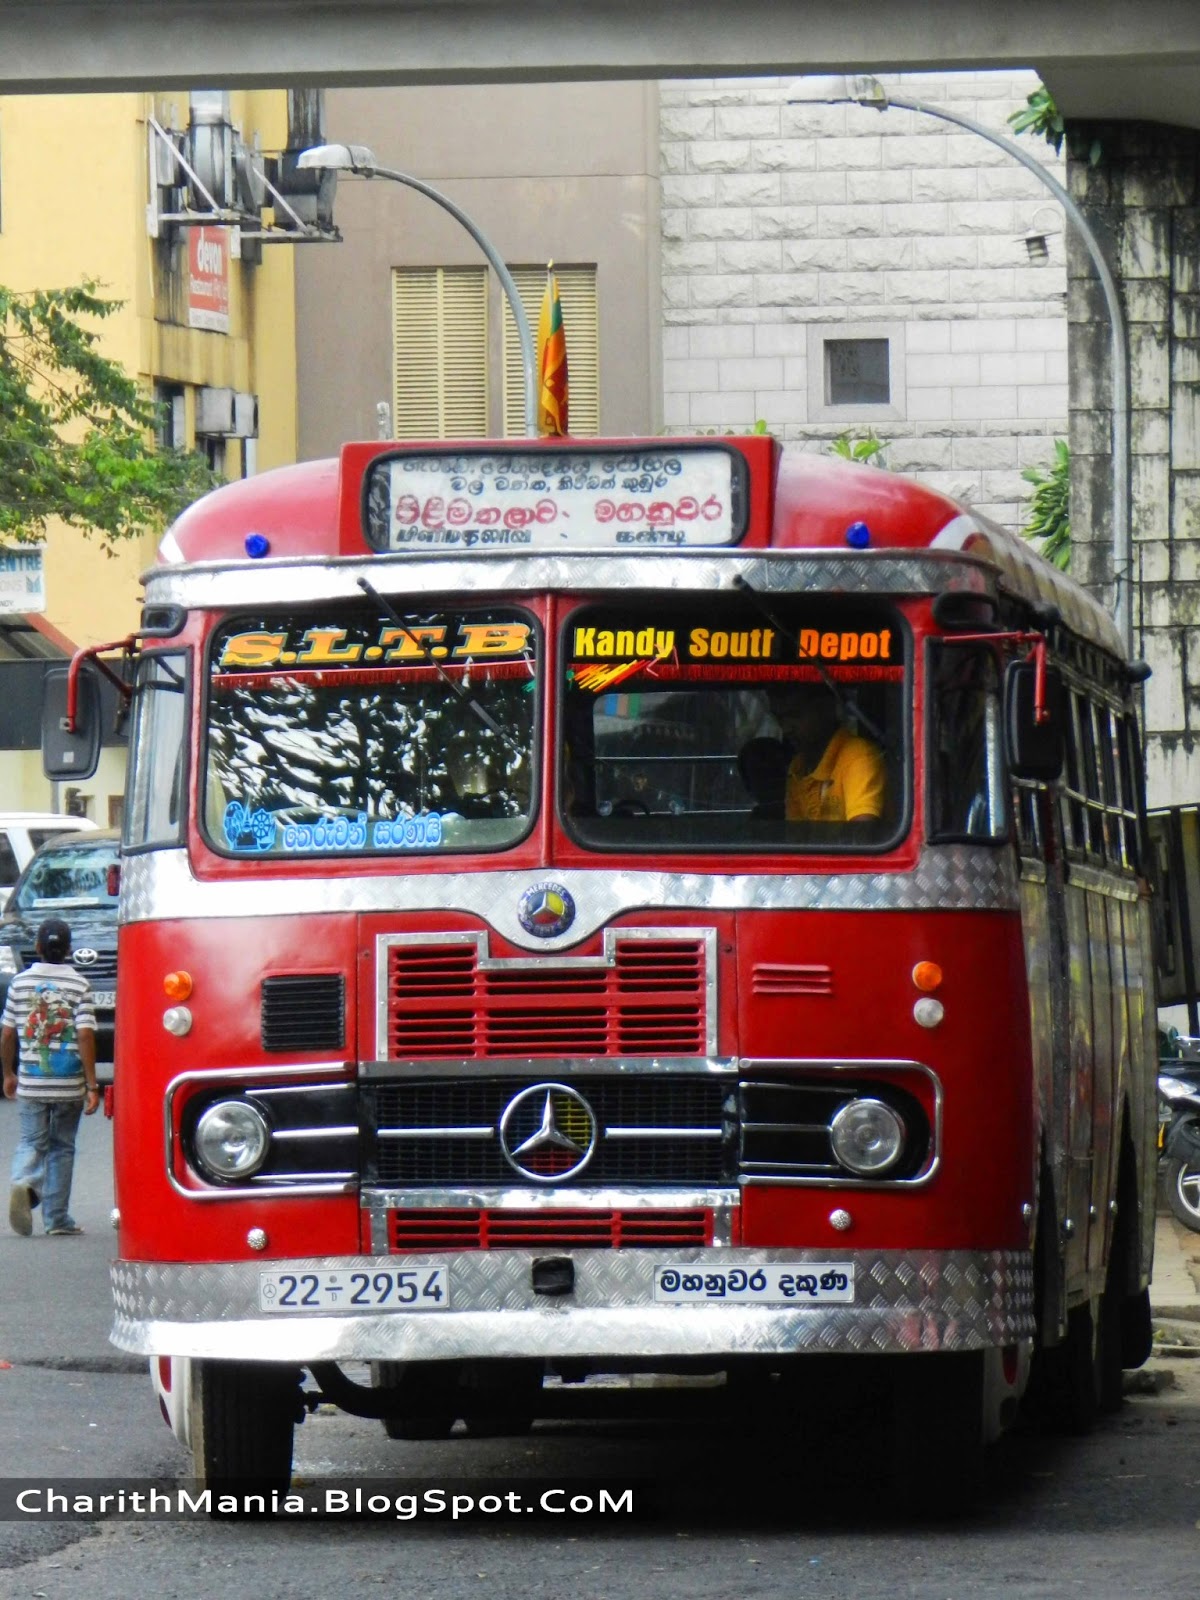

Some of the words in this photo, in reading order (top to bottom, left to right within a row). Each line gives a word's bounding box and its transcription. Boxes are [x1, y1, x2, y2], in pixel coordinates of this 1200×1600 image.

[594, 495, 723, 526] මහනුවර
[574, 627, 675, 658] Kandy
[799, 629, 891, 661] Depot
[660, 1268, 767, 1297] මහනුවර
[778, 1269, 848, 1297] දකුණ
